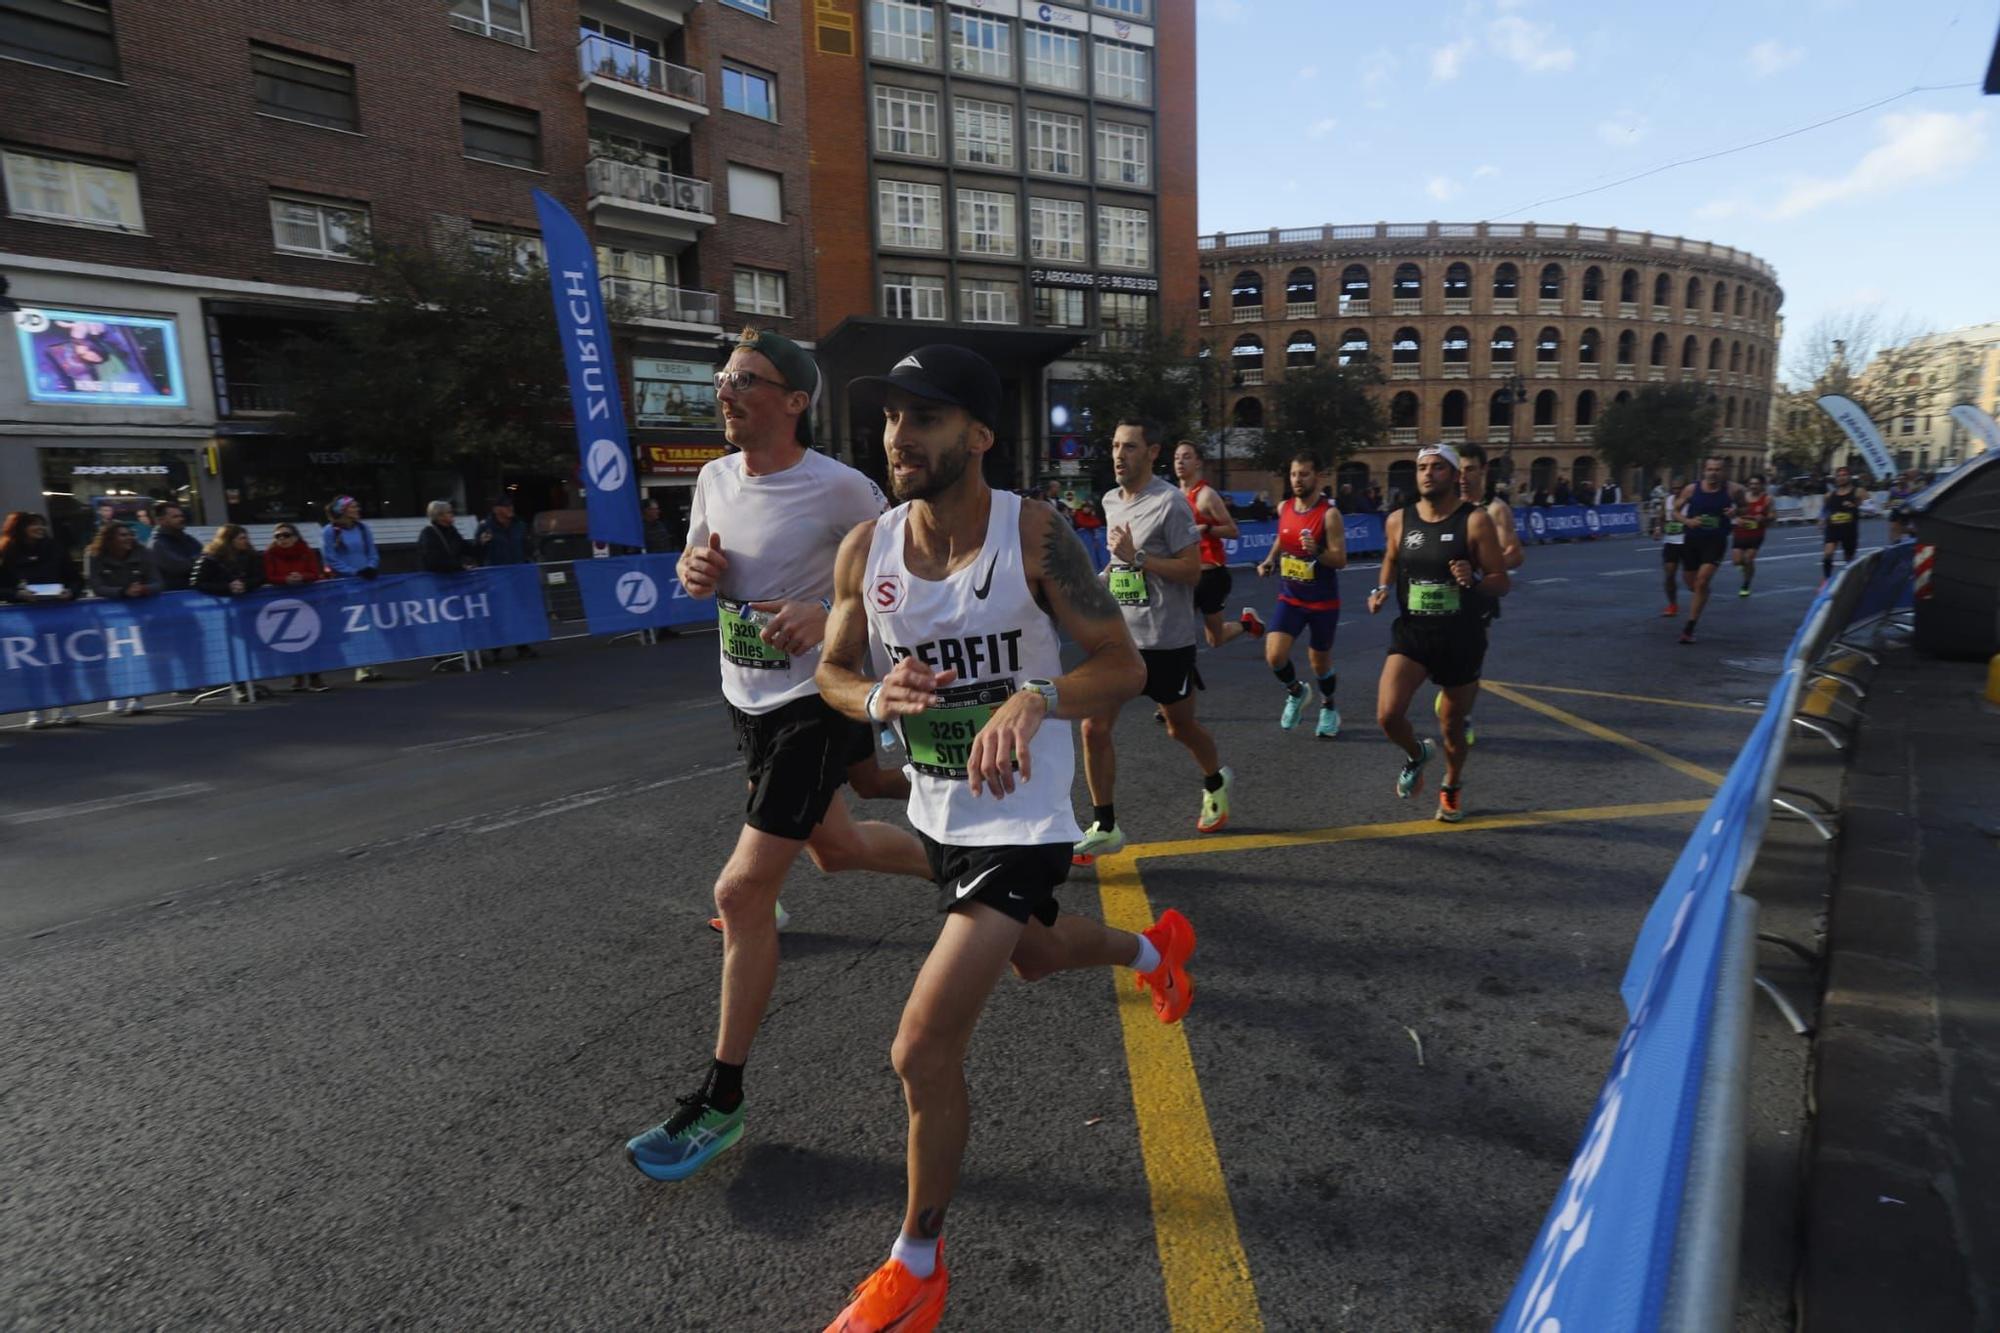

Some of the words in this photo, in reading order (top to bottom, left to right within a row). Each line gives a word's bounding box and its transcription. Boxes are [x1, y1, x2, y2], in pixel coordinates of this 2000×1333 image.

[1045, 270, 1094, 285] ABOGADOS
[342, 593, 491, 633] ZURICH
[728, 622, 757, 639] 1920
[728, 640, 764, 659] Gilles
[929, 719, 976, 740] 3261
